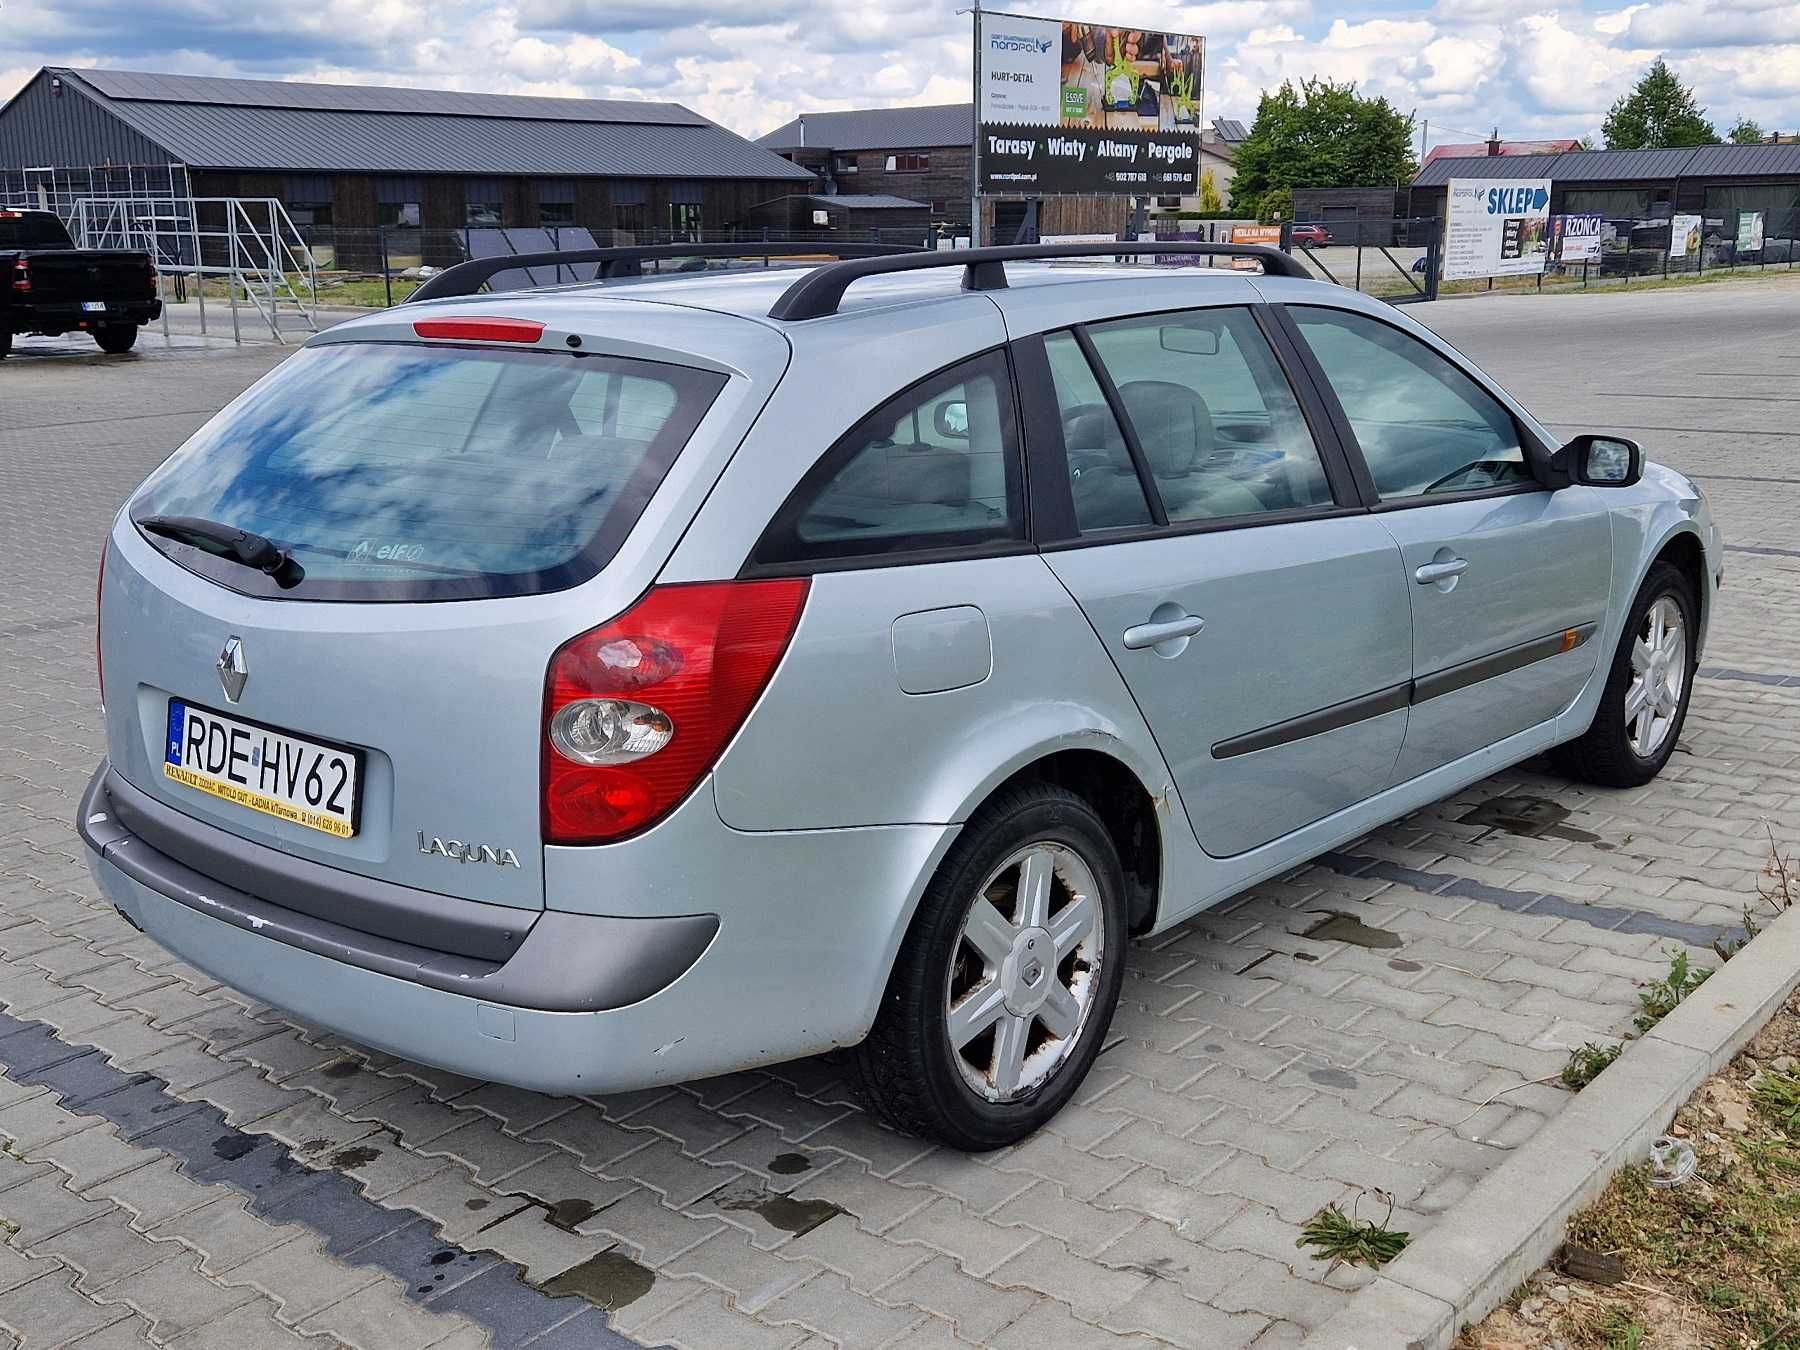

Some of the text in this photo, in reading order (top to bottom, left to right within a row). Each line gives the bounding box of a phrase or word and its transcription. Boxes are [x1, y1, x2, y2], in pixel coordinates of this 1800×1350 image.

[991, 71, 1034, 83] HURT-DETAL
[988, 135, 1193, 164] Tarasy Wiaty Altany Pergole
[1487, 187, 1535, 215] SKLEP
[1565, 214, 1601, 236] RZOŃCA
[171, 741, 181, 757] PL
[186, 714, 348, 815] RDE HV62
[166, 764, 198, 786] RENAULT
[217, 784, 237, 799] WITOLD
[307, 812, 321, 828] (014)
[417, 829, 521, 869] LAGUNA
